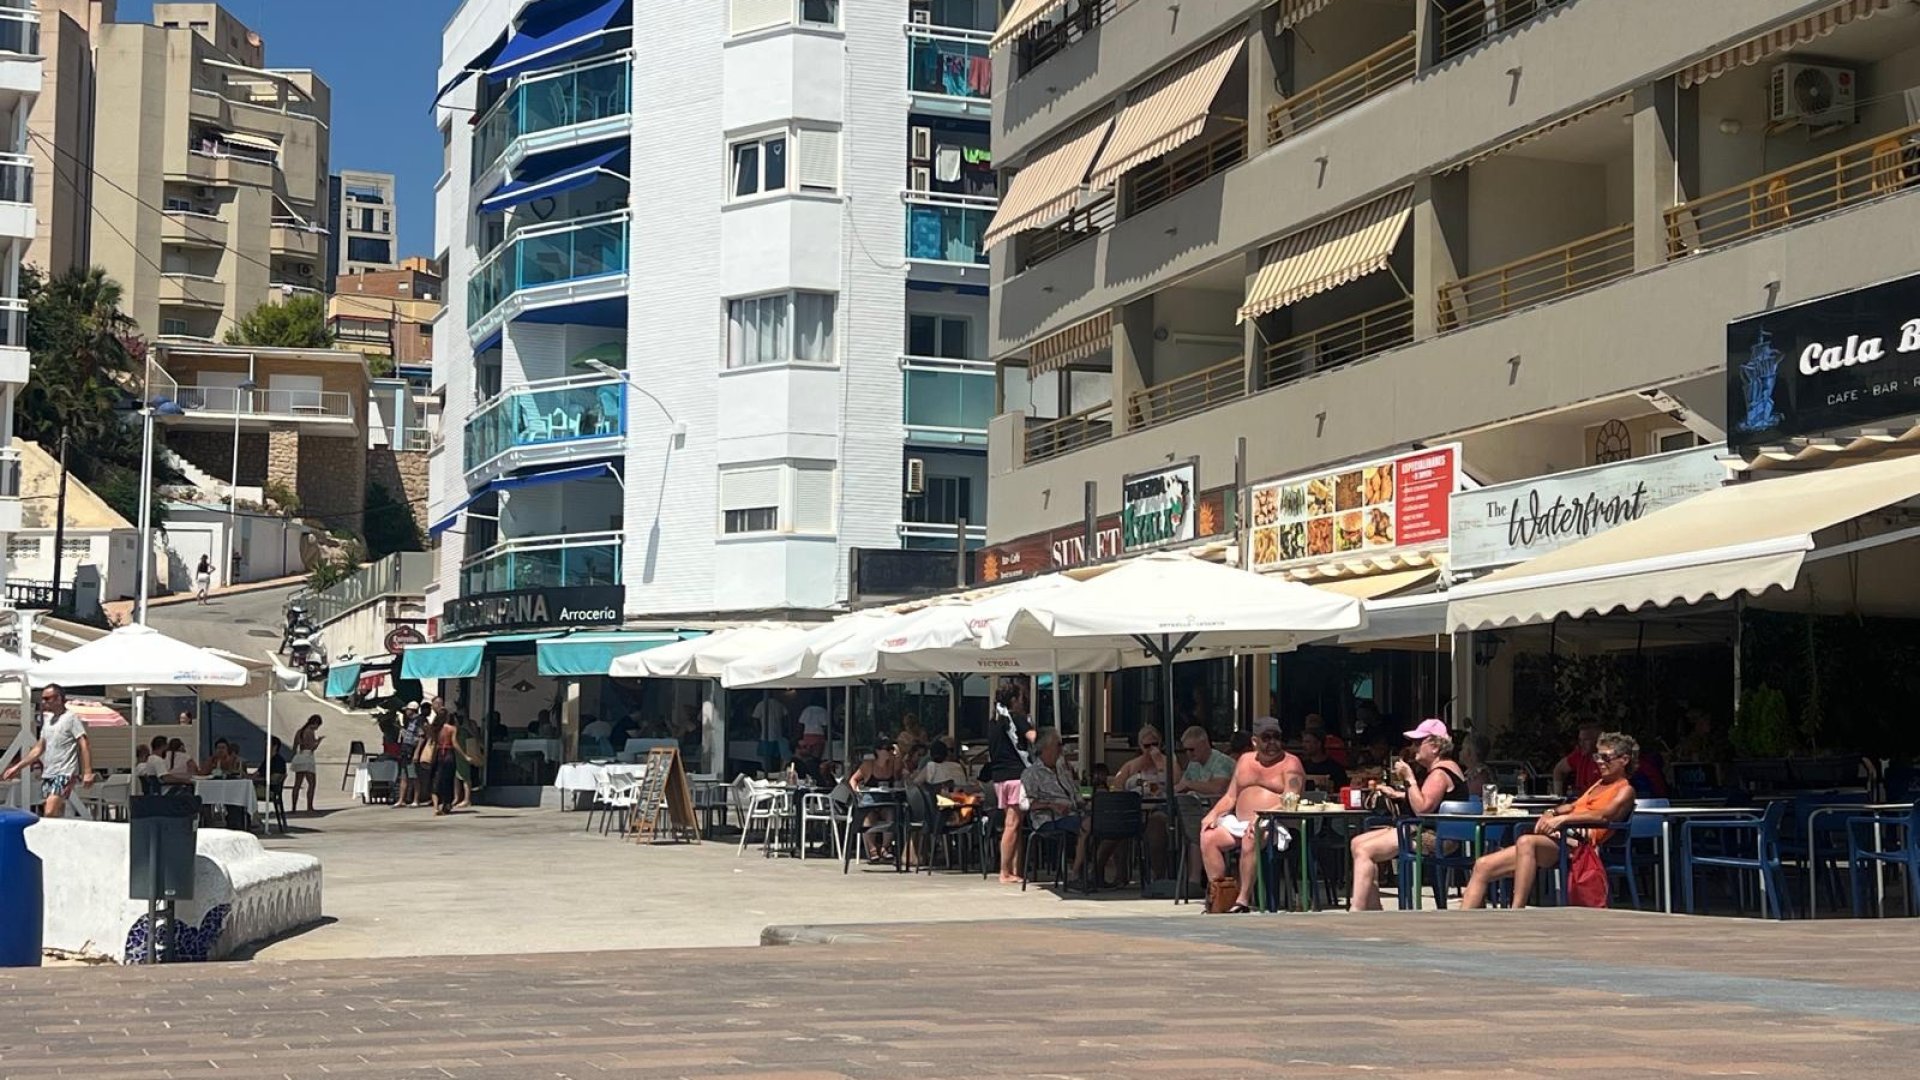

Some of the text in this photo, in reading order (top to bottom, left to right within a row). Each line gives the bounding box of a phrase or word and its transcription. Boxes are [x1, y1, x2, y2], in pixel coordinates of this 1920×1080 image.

[1799, 335, 1885, 375] Cala
[1827, 389, 1858, 405] CAFE
[1872, 381, 1898, 396] BAR
[1486, 480, 1648, 547] The Waterfront
[1052, 527, 1121, 568] SUNET
[559, 606, 616, 621] Arrocería
